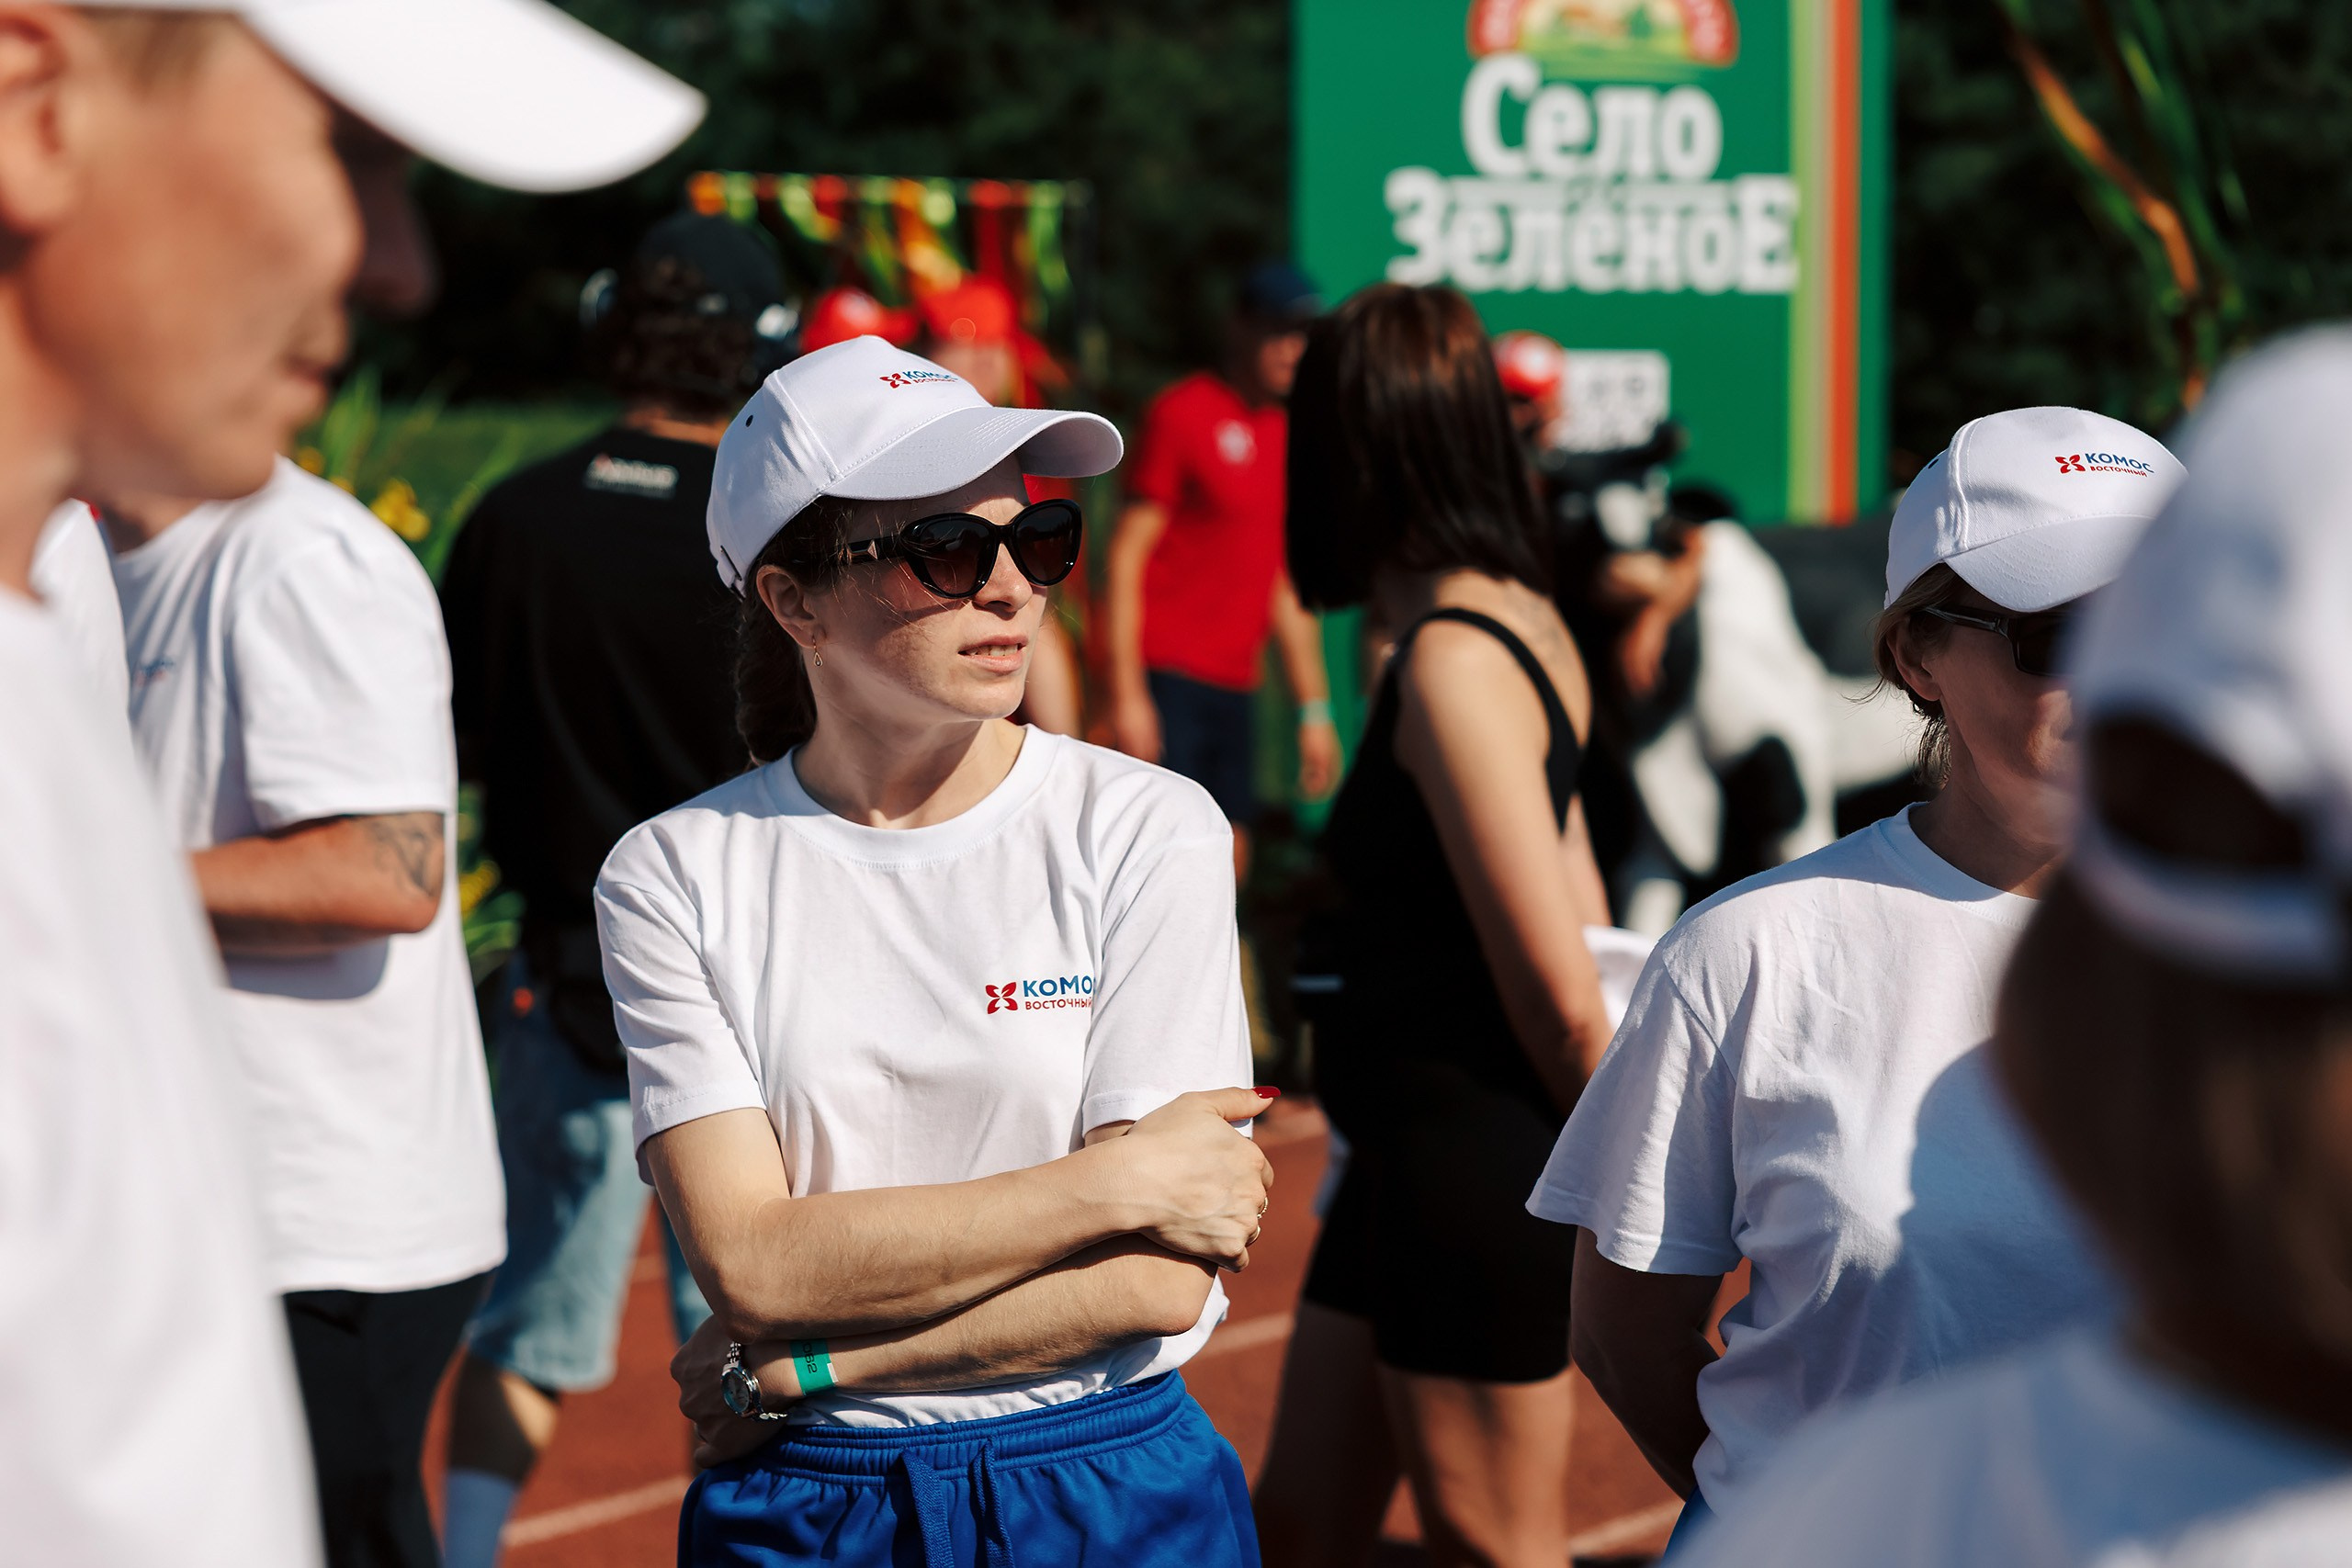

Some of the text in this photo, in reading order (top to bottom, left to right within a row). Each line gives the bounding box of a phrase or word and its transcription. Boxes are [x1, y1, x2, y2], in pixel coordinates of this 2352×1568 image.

[1461, 54, 1722, 181] Село
[2085, 453, 2154, 473] КОМОС
[2090, 466, 2147, 478] ВОСТОЧНЫЙ
[1023, 976, 1096, 998] КОМО
